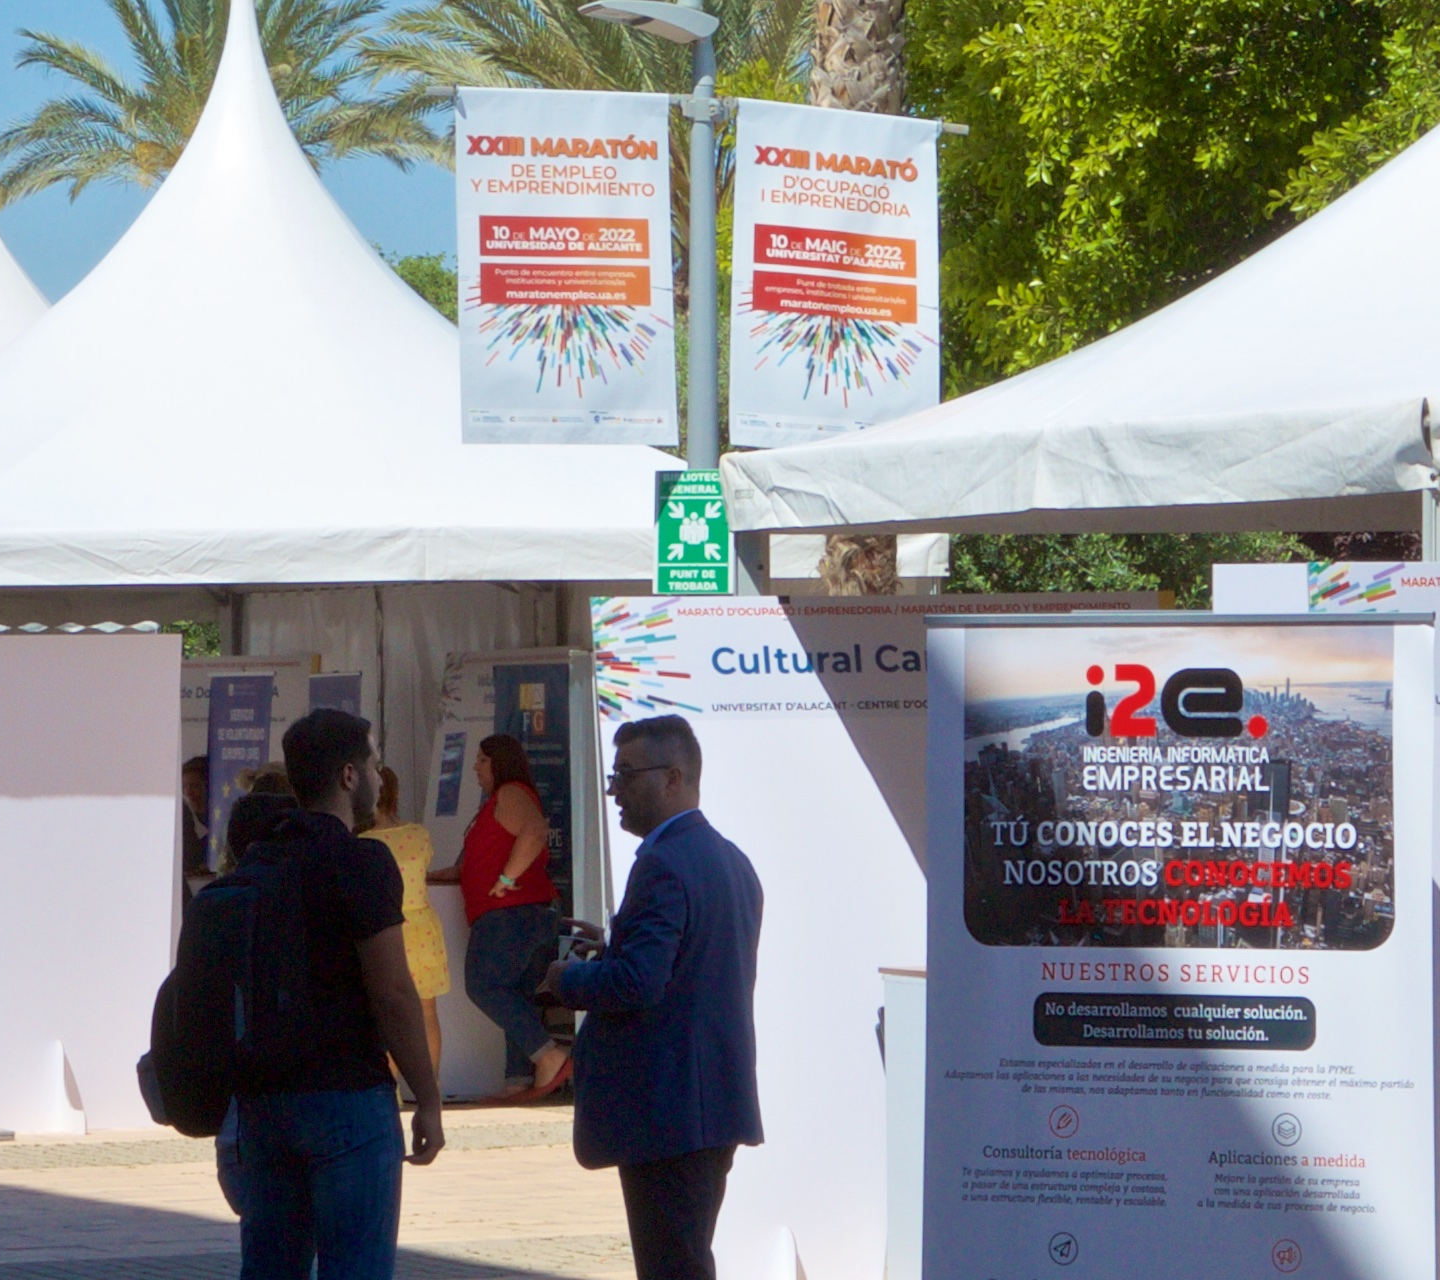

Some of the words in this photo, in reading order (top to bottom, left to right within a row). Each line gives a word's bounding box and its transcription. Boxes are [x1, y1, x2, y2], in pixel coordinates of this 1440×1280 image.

[466, 135, 525, 157] XXIII
[530, 134, 658, 161] MARATÓN
[511, 164, 536, 178] DE
[541, 165, 617, 180] EMPLEO
[754, 145, 811, 169] XXIII
[815, 152, 919, 182] MARATÓ
[471, 178, 482, 193] Y
[487, 179, 655, 197] EMPRENDIMIENTO
[783, 174, 890, 200] D'OCUPACIÓ
[770, 190, 911, 218] EMPRENEDORIA
[492, 225, 510, 240] 10
[529, 226, 580, 241] MAYO
[599, 228, 636, 242] 2022
[485, 240, 566, 251] UNIVERSIDAD
[568, 241, 585, 252] DE
[587, 241, 643, 253] ALICANTE
[769, 234, 788, 249] 10
[805, 237, 848, 255] MAIG
[864, 244, 902, 261] 2022
[766, 248, 840, 264] UNIVERSITAT
[842, 255, 906, 271] D'ALACANT
[506, 289, 627, 301] maratonempleo.ua.es
[779, 298, 892, 318] maratonempleo.ua.es
[663, 472, 719, 481] BIBLIOTEC
[669, 484, 719, 494] GENERAL
[669, 569, 699, 579] PUNT
[701, 569, 716, 579] DE
[667, 581, 719, 591] TROBADA
[677, 604, 724, 617] MARATÓ
[727, 604, 796, 617] D'OCUPACIÓ
[804, 604, 893, 617] EMPRENEDORIA
[901, 603, 956, 615] MARATÓN
[959, 603, 973, 614] DE
[976, 603, 1021, 613] EMPLEO
[1023, 602, 1030, 612] Y
[1032, 601, 1131, 612] EMPRENDIMIENTO
[712, 643, 862, 676] Cultural
[874, 645, 928, 672] Ca
[712, 702, 782, 713] UNIVERSITAT
[785, 700, 848, 712] D'ALACANT
[857, 699, 900, 710] CENTRE
[1083, 746, 1163, 764] INGENIERIA
[1166, 746, 1270, 764] INFORMATICA
[1082, 764, 1271, 793] EMPRESARIAL
[990, 813, 1030, 847] TÚ
[1036, 820, 1174, 848] CONOCES
[1181, 820, 1217, 848] EL
[1220, 820, 1365, 850] NEGOCIO.
[1003, 859, 1158, 887] NOSOTROS
[1164, 860, 1354, 890] CONOCEMOS
[1059, 898, 1095, 926] LA
[1102, 894, 1294, 928] TECNOLOGÍA
[1041, 962, 1170, 982] NUESTROS
[1180, 964, 1310, 985] SERVICIOS
[1045, 1001, 1065, 1017] No
[1067, 1001, 1168, 1018] desarrollamos
[1173, 1003, 1242, 1022] cualquier
[1243, 1004, 1308, 1021] solución.
[1083, 1023, 1185, 1040] Desarrollamos
[1187, 1026, 1203, 1040] tu
[1205, 1025, 1270, 1042] solución.
[982, 1144, 1063, 1160] Consultoría
[1066, 1146, 1147, 1165] tecnológica
[1207, 1150, 1298, 1168] Aplicaciones
[1301, 1155, 1309, 1167] a
[1313, 1153, 1366, 1169] medida
